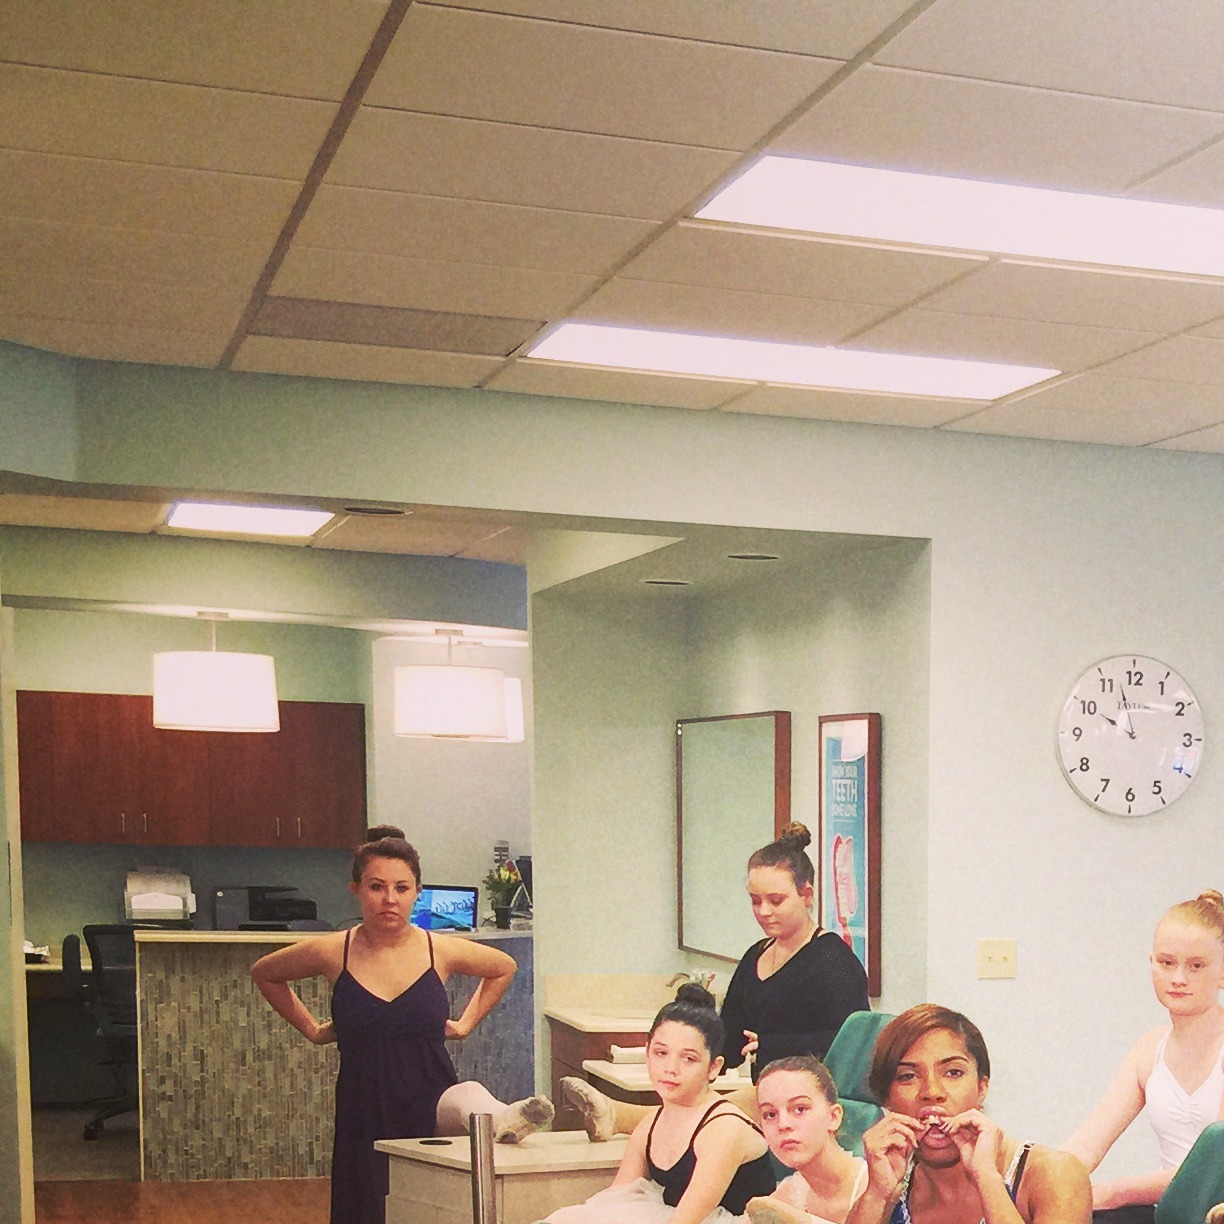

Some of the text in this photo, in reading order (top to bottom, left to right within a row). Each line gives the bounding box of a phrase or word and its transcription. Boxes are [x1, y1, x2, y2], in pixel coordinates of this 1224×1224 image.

[1100, 678, 1114, 693] 11
[1126, 671, 1143, 686] 12
[1158, 681, 1165, 695] 1
[1080, 700, 1097, 715] 10
[1174, 701, 1185, 716] 2
[1072, 726, 1082, 741] 9
[1182, 732, 1193, 747] 3
[1079, 757, 1090, 772] 8
[1172, 760, 1184, 774] 4
[832, 778, 858, 802] TEETH
[1100, 778, 1110, 792] 7
[1151, 780, 1162, 795] 5
[1125, 787, 1136, 802] 6
